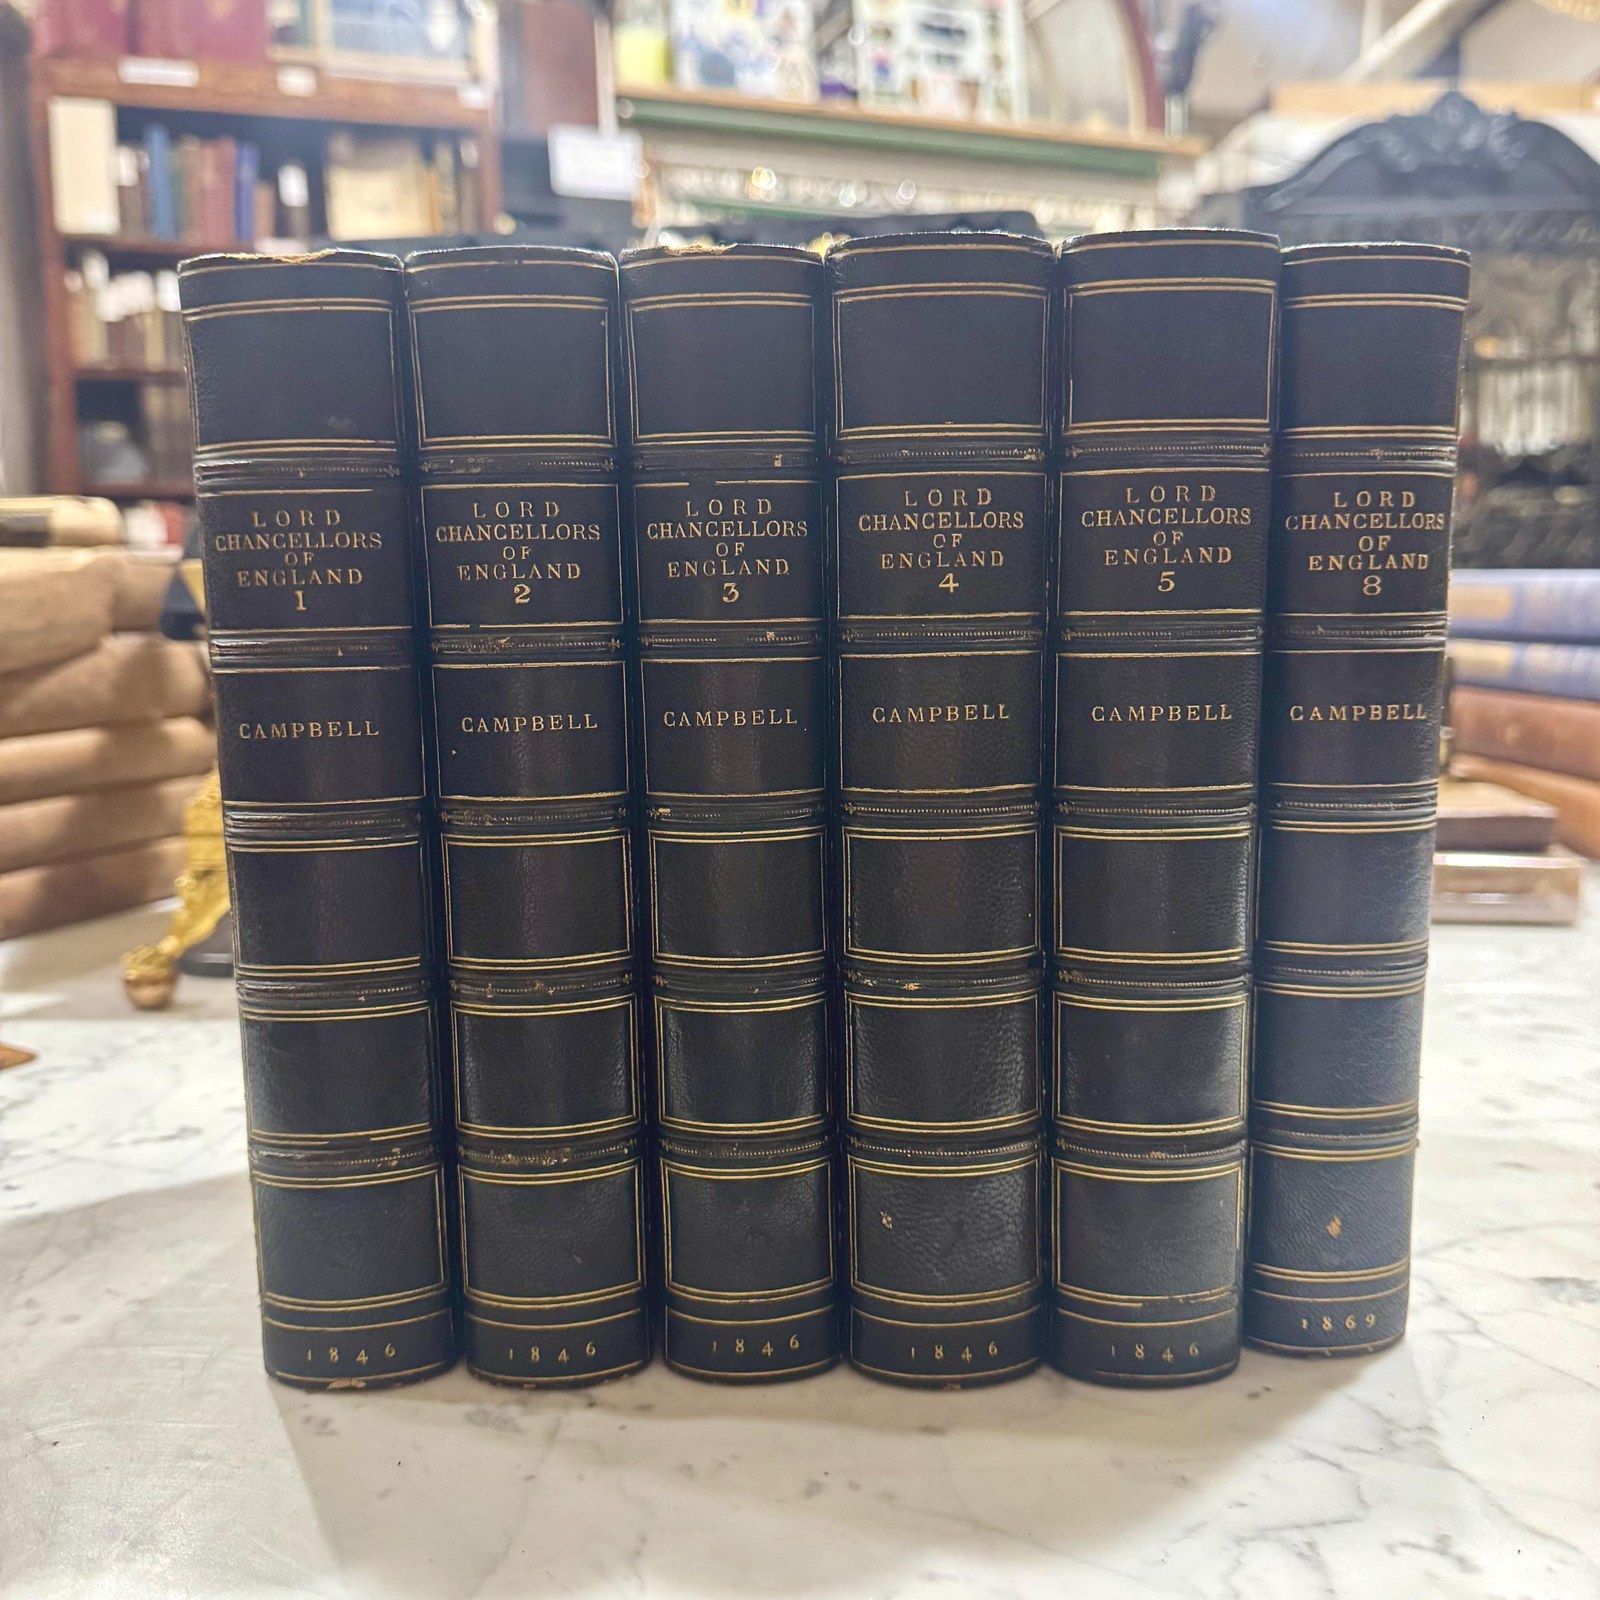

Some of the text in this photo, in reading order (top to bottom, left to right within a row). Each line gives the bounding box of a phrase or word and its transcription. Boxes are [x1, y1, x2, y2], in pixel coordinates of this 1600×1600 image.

[905, 488, 993, 506] LORD
[1126, 485, 1216, 503] LORD
[1334, 491, 1415, 508] LORD
[473, 501, 560, 518] LORD
[686, 499, 772, 516] LORD
[1081, 507, 1251, 527] CHANCELLORS
[253, 509, 341, 528] LORD
[859, 511, 1024, 531] CHANCELLORS
[1285, 512, 1444, 531] CHANCELLORS
[436, 524, 601, 542] CHANCELLORS
[646, 520, 808, 538] CHANCELLORS
[1153, 530, 1184, 546] OF
[215, 532, 382, 551] CHANCELLORS
[716, 542, 745, 557] OF
[933, 533, 962, 549] OF
[1359, 536, 1391, 551] OF
[284, 552, 314, 567] OF
[503, 545, 531, 560] OF
[880, 550, 1004, 569] ENGLAND
[1104, 546, 1232, 565] ENGLAND
[1308, 553, 1428, 571] ENGLAND
[458, 562, 581, 580] ENGLAND
[667, 558, 789, 577] ENGLAND
[237, 568, 363, 587] ENGLAND
[938, 573, 959, 593] 4
[1158, 572, 1174, 592] 5
[1362, 575, 1381, 596] 8
[295, 591, 306, 610] 1
[515, 584, 530, 603] 2
[723, 583, 739, 602] 3
[663, 708, 797, 727] CAMPBELL
[872, 704, 1009, 723] CAMPBELL
[1091, 704, 1232, 722] CAMPBELL
[1289, 703, 1426, 721] CAMPBELL
[239, 721, 379, 739] CAMPBELL
[461, 714, 597, 733] CAMPBELL
[1301, 1314, 1376, 1331] 1869
[306, 1343, 396, 1365] 1846
[508, 1341, 596, 1365] 1846
[711, 1334, 800, 1357] 1846
[910, 1341, 998, 1363] 1846
[1110, 1343, 1199, 1363] 1846
